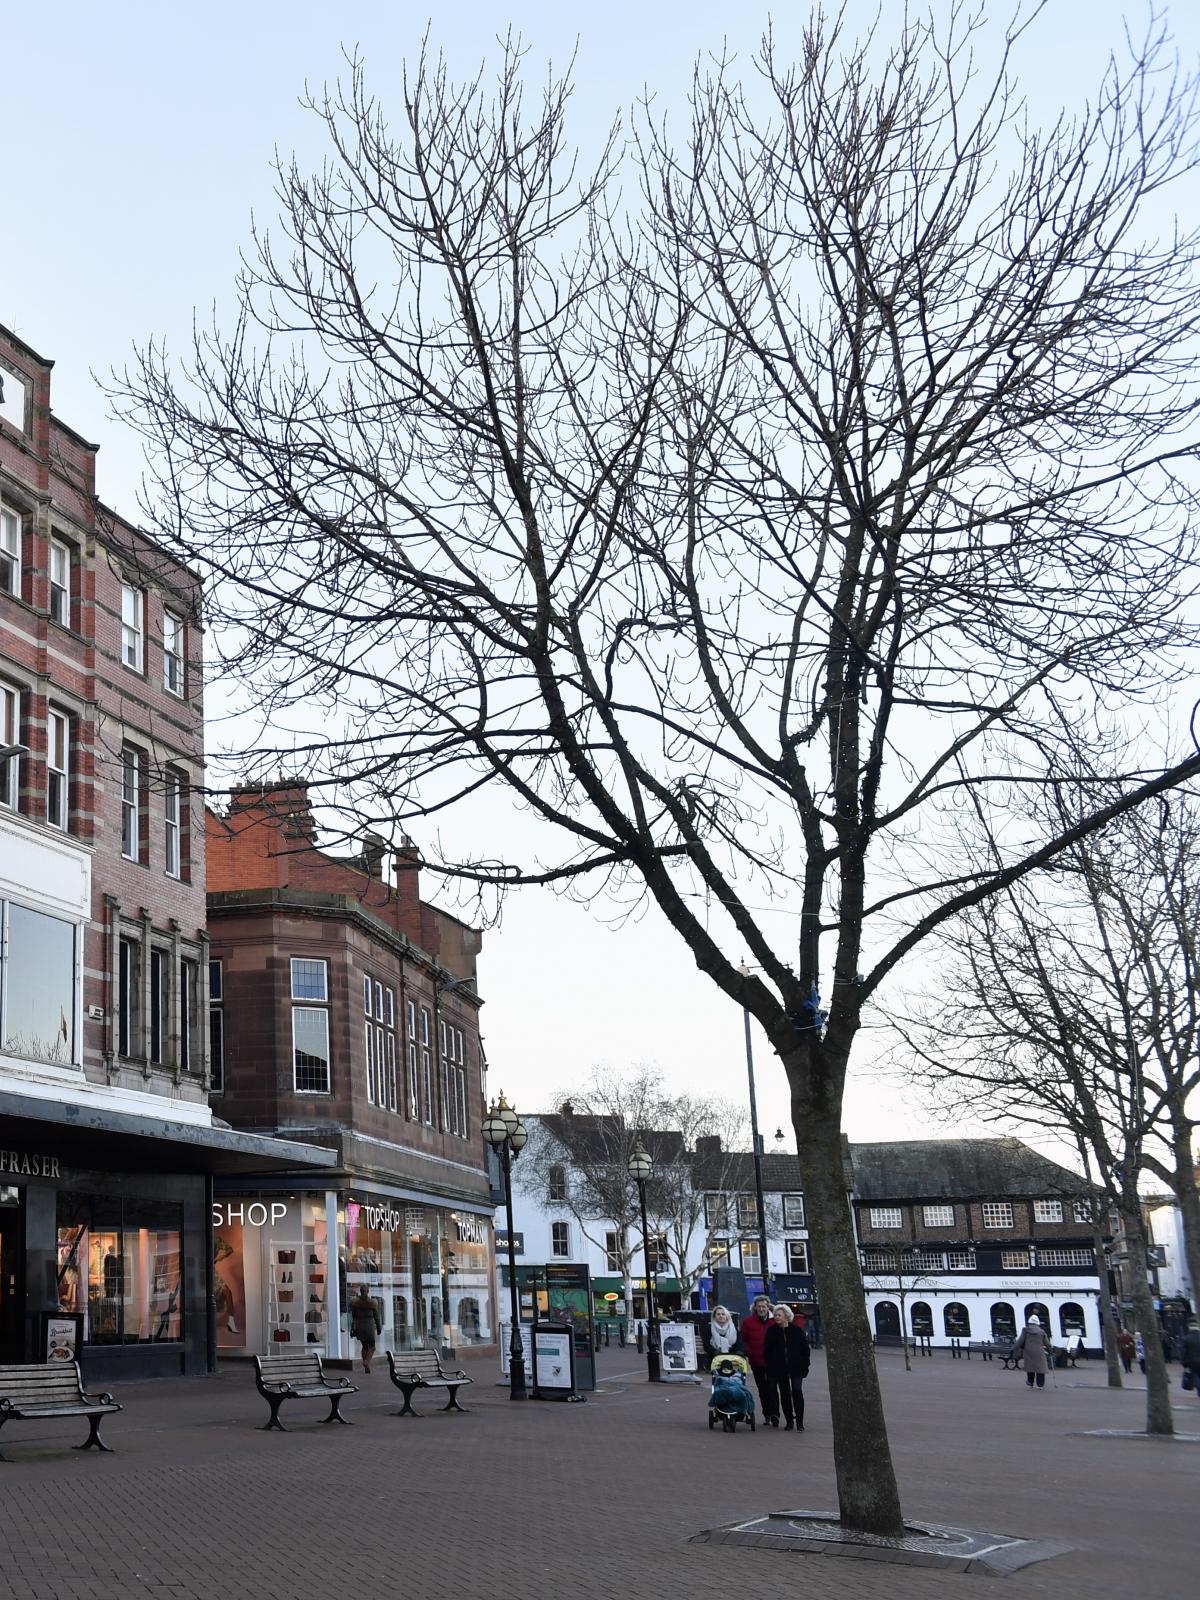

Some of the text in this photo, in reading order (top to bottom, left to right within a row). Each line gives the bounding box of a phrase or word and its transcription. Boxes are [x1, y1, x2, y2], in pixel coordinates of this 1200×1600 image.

[0, 1150, 61, 1178] FRASER
[212, 1203, 287, 1227] SHOP
[365, 1206, 400, 1233] TOPSHOP
[457, 1222, 484, 1244] TOPMAN
[787, 1286, 809, 1294] THE
